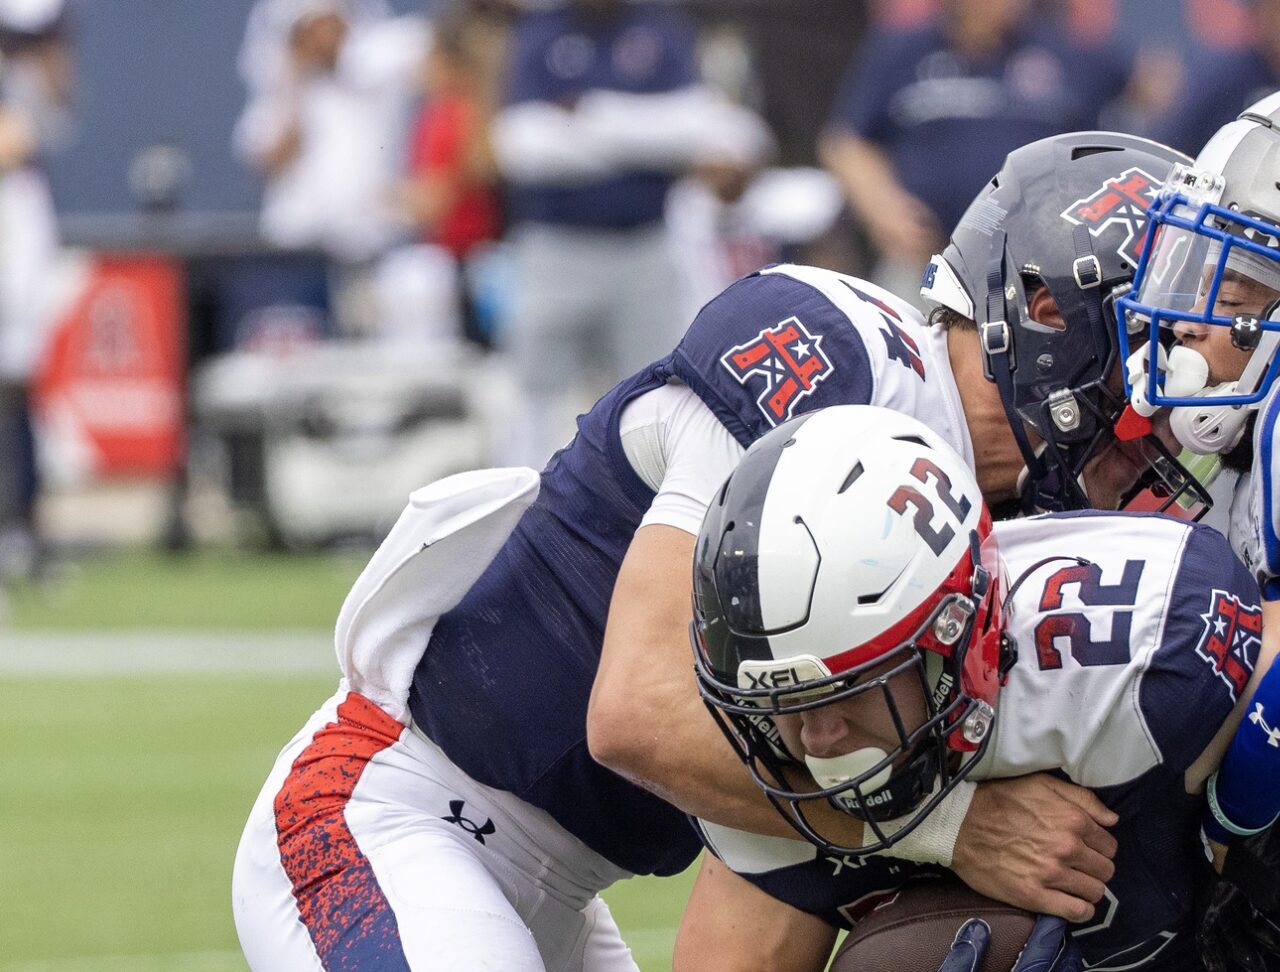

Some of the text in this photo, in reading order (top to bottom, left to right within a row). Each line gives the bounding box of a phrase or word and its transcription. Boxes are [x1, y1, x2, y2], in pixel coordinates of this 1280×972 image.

[886, 457, 972, 558] 22
[1034, 559, 1146, 671] 22
[845, 789, 894, 809] Ridell
